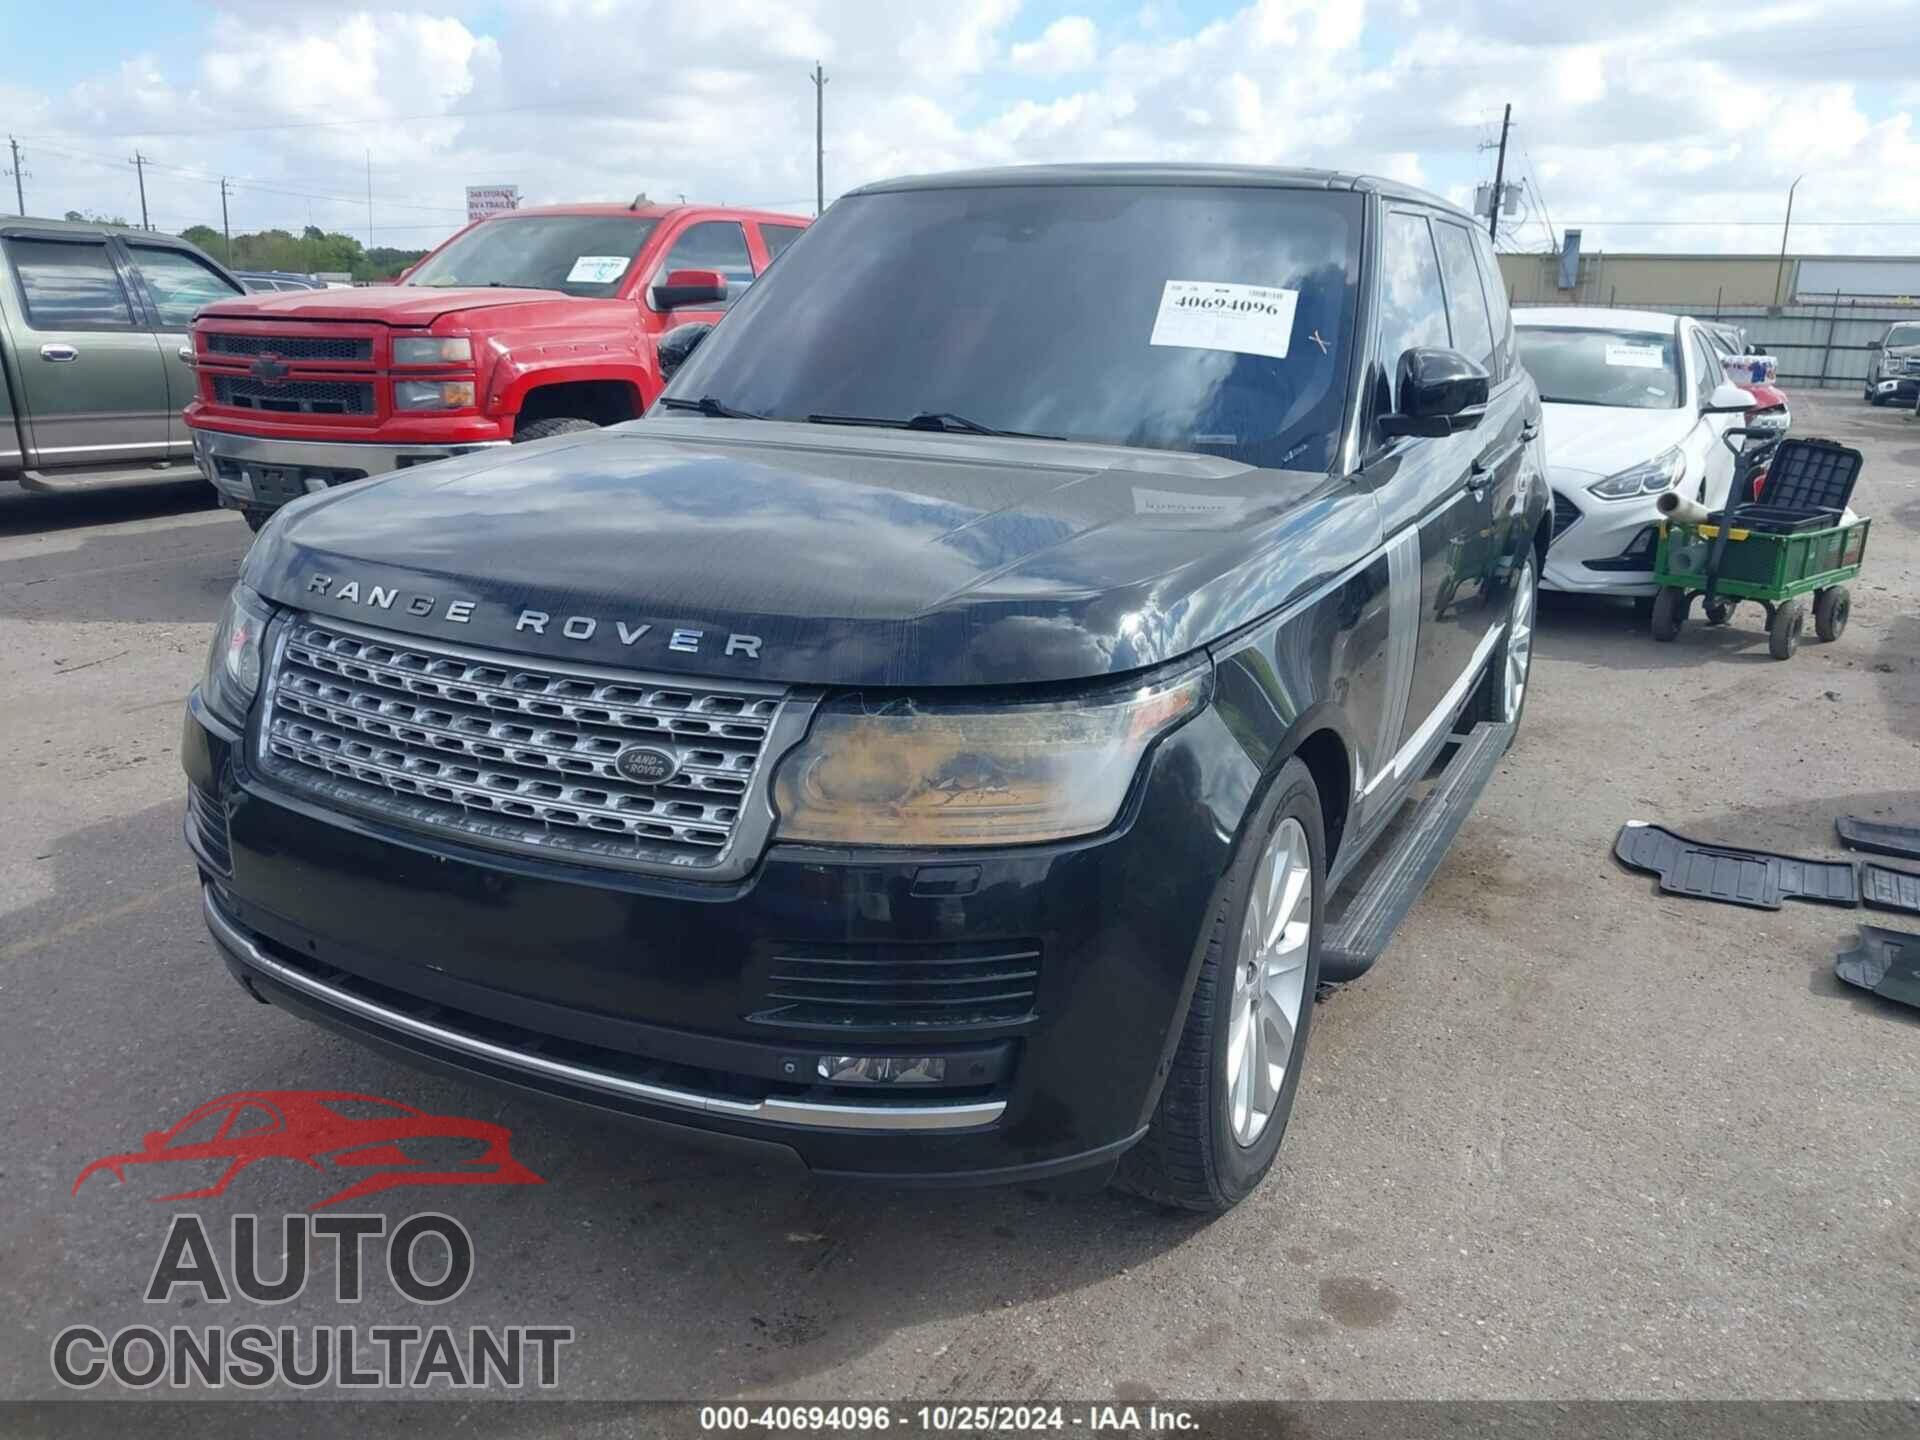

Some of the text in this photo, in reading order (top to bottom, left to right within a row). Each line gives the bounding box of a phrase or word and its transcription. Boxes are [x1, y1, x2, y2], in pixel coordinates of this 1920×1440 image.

[1175, 296, 1278, 316] 40694096
[307, 573, 763, 659] RANGE ROVER
[628, 754, 657, 766] LAND
[629, 763, 665, 776] ROVER
